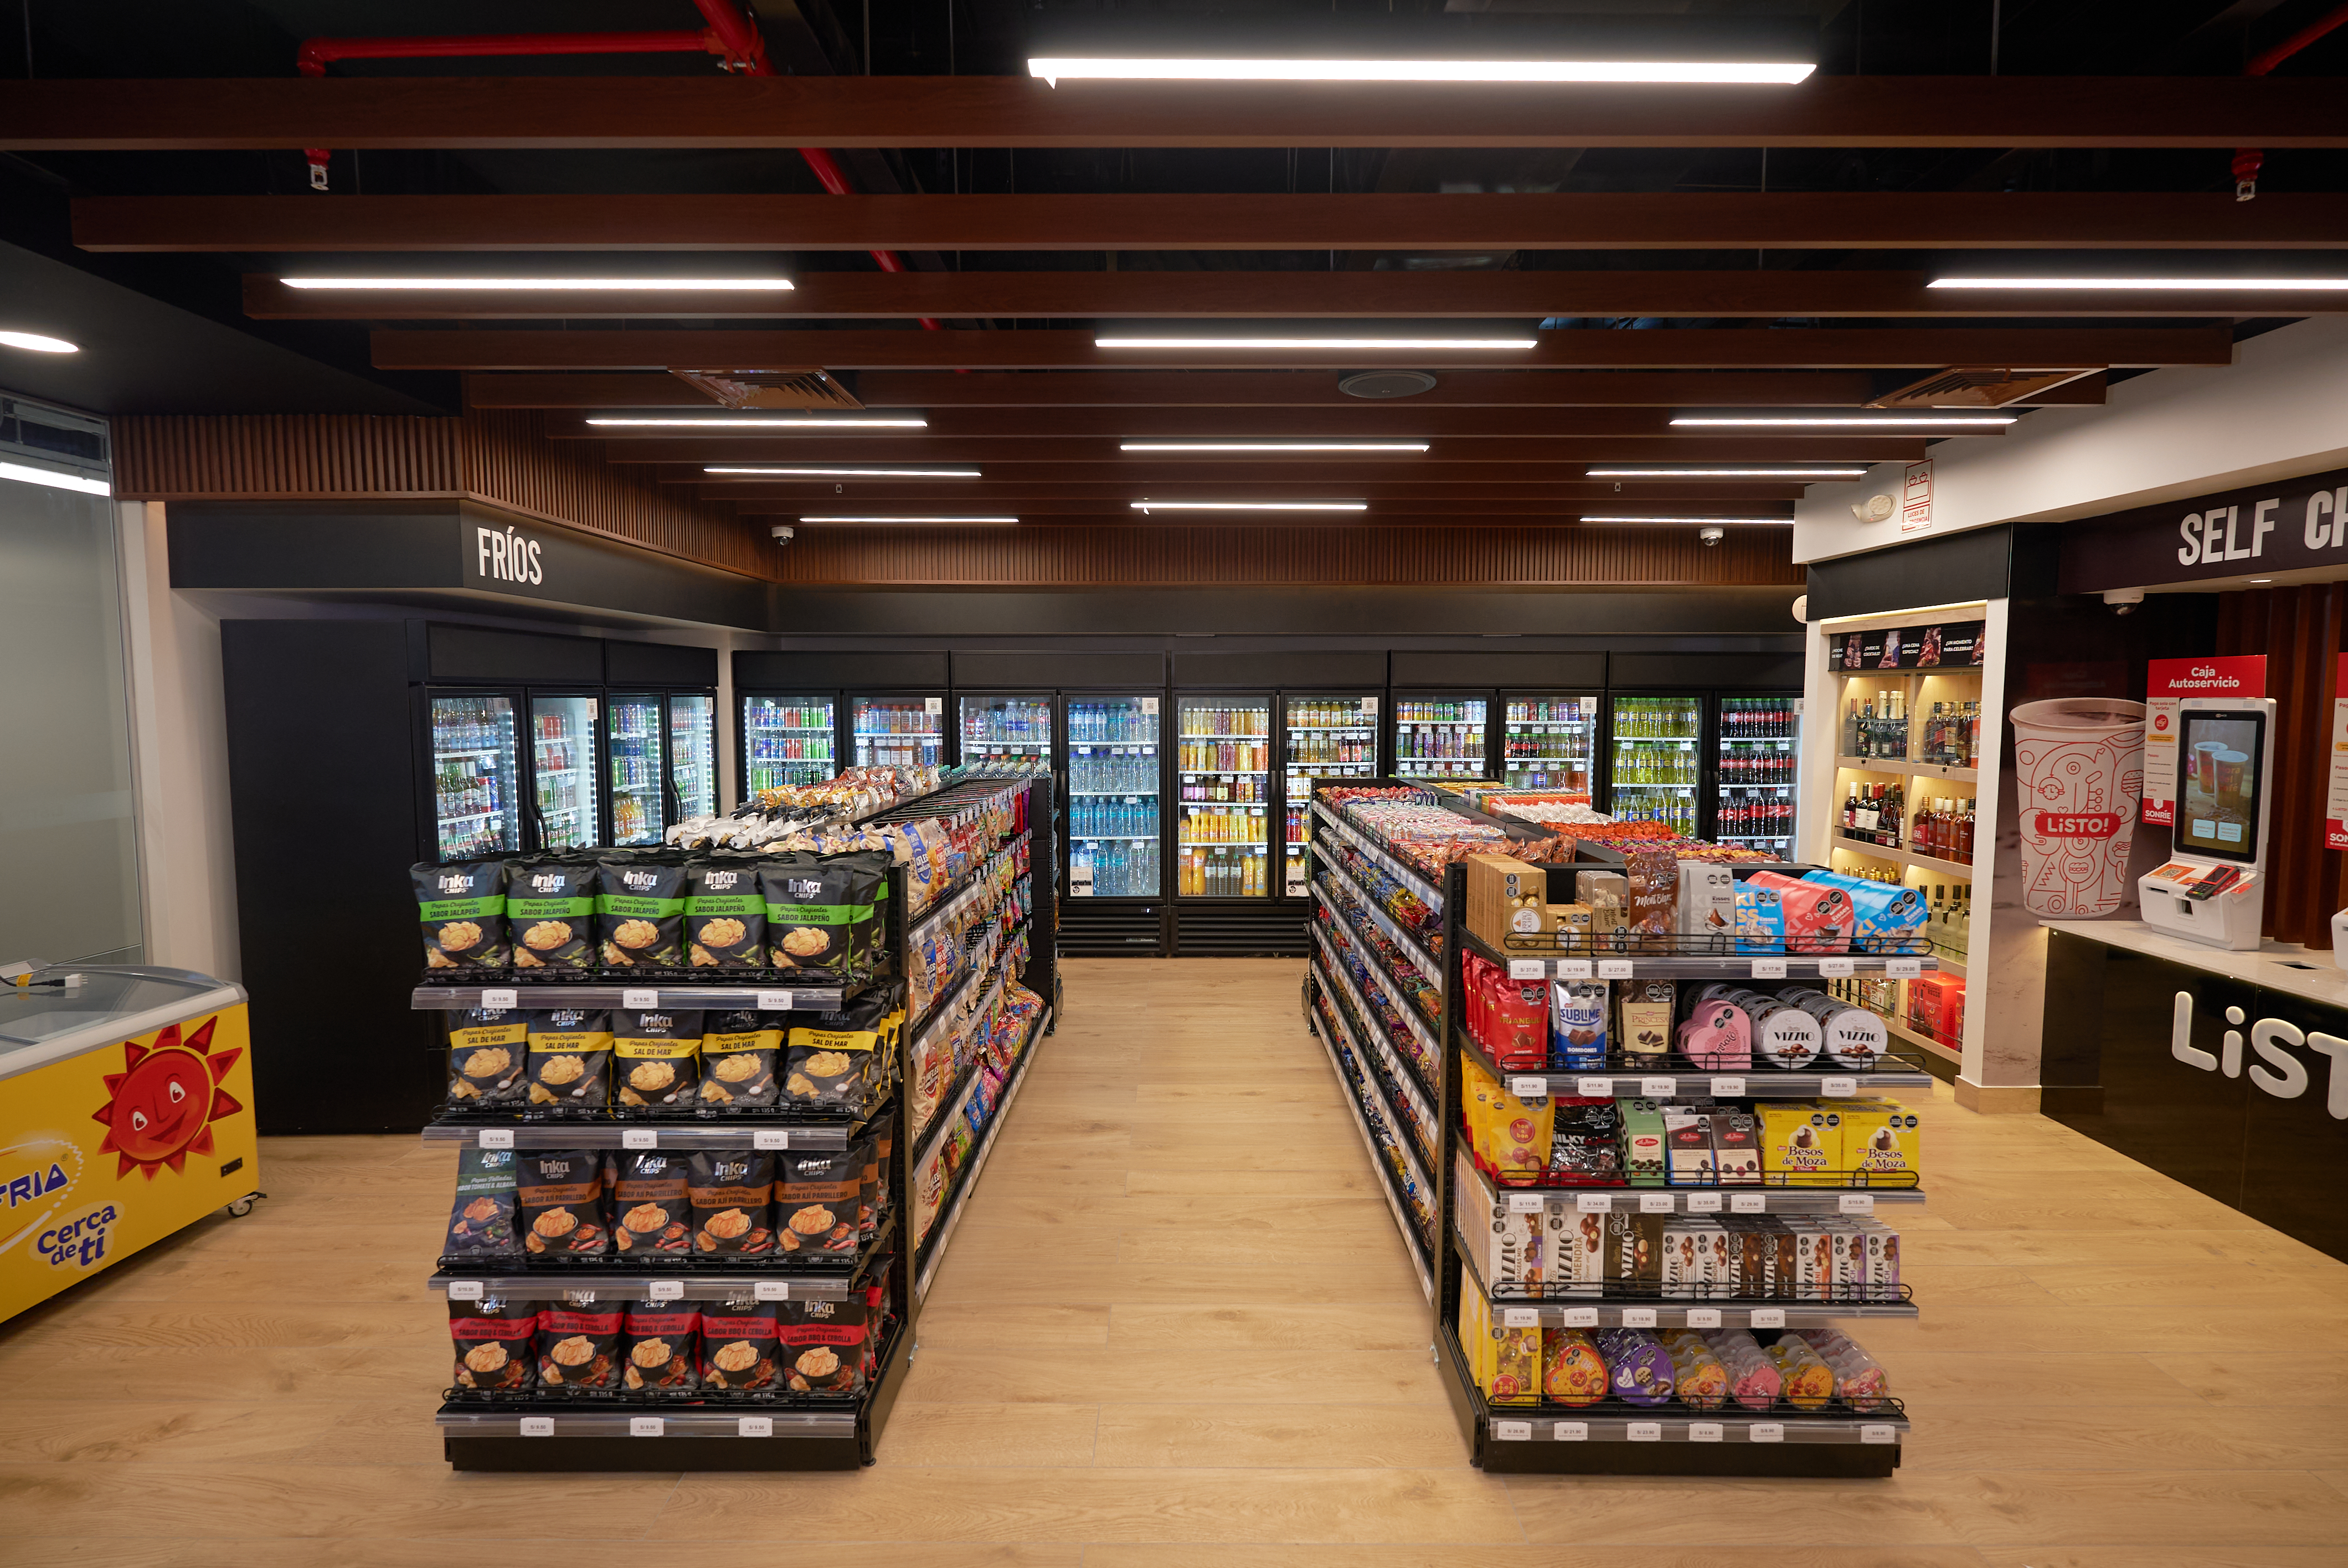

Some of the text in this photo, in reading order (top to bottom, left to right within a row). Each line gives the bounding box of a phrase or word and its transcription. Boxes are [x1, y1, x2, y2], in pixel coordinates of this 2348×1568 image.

[2179, 498, 2279, 566] SELF
[478, 525, 543, 585] FRÍOS
[2191, 666, 2215, 678] Caja
[2169, 676, 2239, 688] Autoservicio
[2145, 809, 2171, 819] SONRÍE
[438, 874, 474, 889] Inka
[532, 874, 565, 888] Inka
[624, 871, 657, 886] Inka
[705, 871, 738, 885] Inka
[788, 879, 821, 894] Inka
[429, 906, 480, 918] SABOR JALAPEÑO
[543, 906, 570, 915] JALAPEÑO
[632, 904, 660, 914] JALAPEÑO
[716, 904, 745, 912] JALAPEÑO
[800, 912, 830, 922] JALAPEÑO
[1560, 1008, 1600, 1020] SUBLIME
[1632, 1015, 1669, 1024] PRINCESA
[640, 1014, 673, 1028] Inka
[1774, 1031, 1815, 1041] VIZZIO
[1839, 1030, 1880, 1043] VIZZIO
[1788, 1146, 1823, 1156] Besos
[1867, 1149, 1902, 1158] Besos
[1796, 1157, 1826, 1166] Moza
[1875, 1159, 1906, 1168] Moza
[38, 1205, 116, 1254] Cerca
[51, 1229, 105, 1266] de ti
